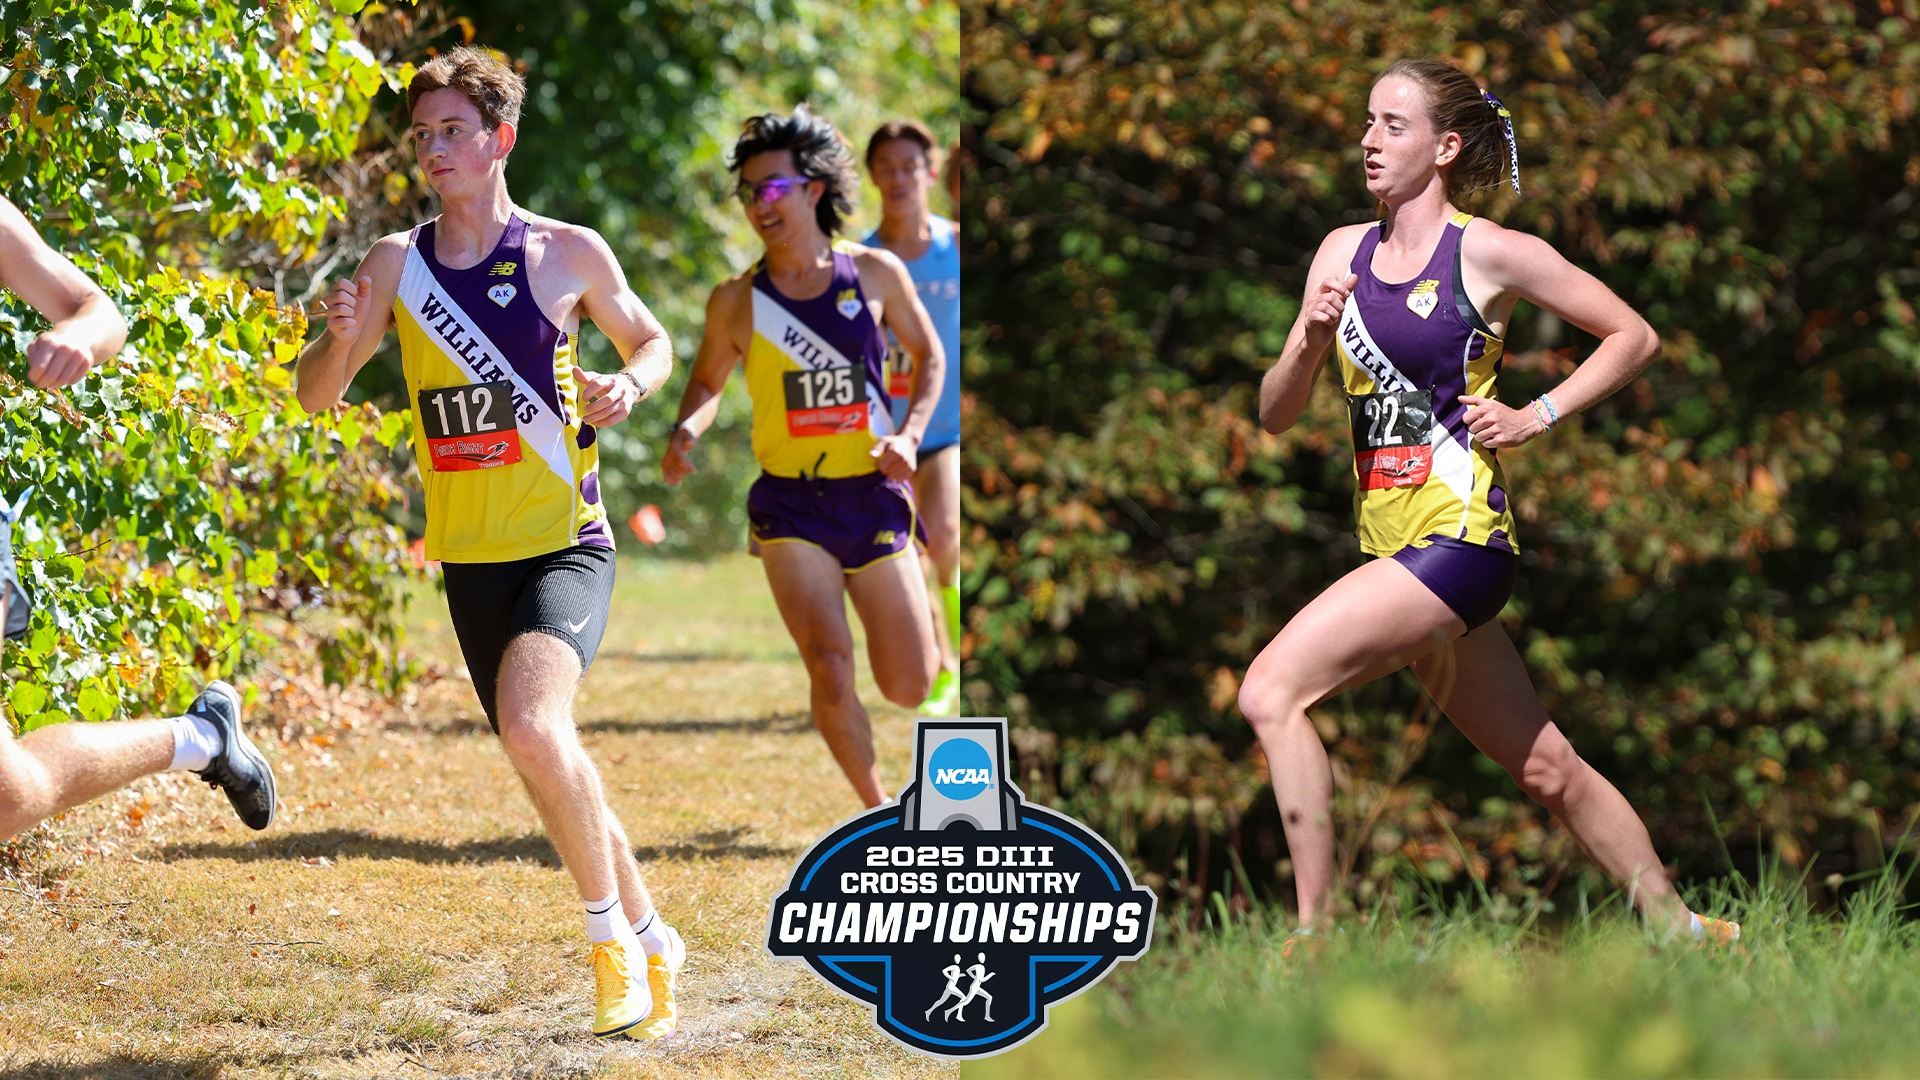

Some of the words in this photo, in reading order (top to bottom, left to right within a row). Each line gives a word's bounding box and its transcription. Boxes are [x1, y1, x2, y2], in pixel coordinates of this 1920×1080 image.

[494, 289, 510, 298] AK
[1415, 297, 1431, 308] AK
[798, 368, 854, 409] 125
[431, 387, 497, 436] 112
[1364, 396, 1403, 447] 22
